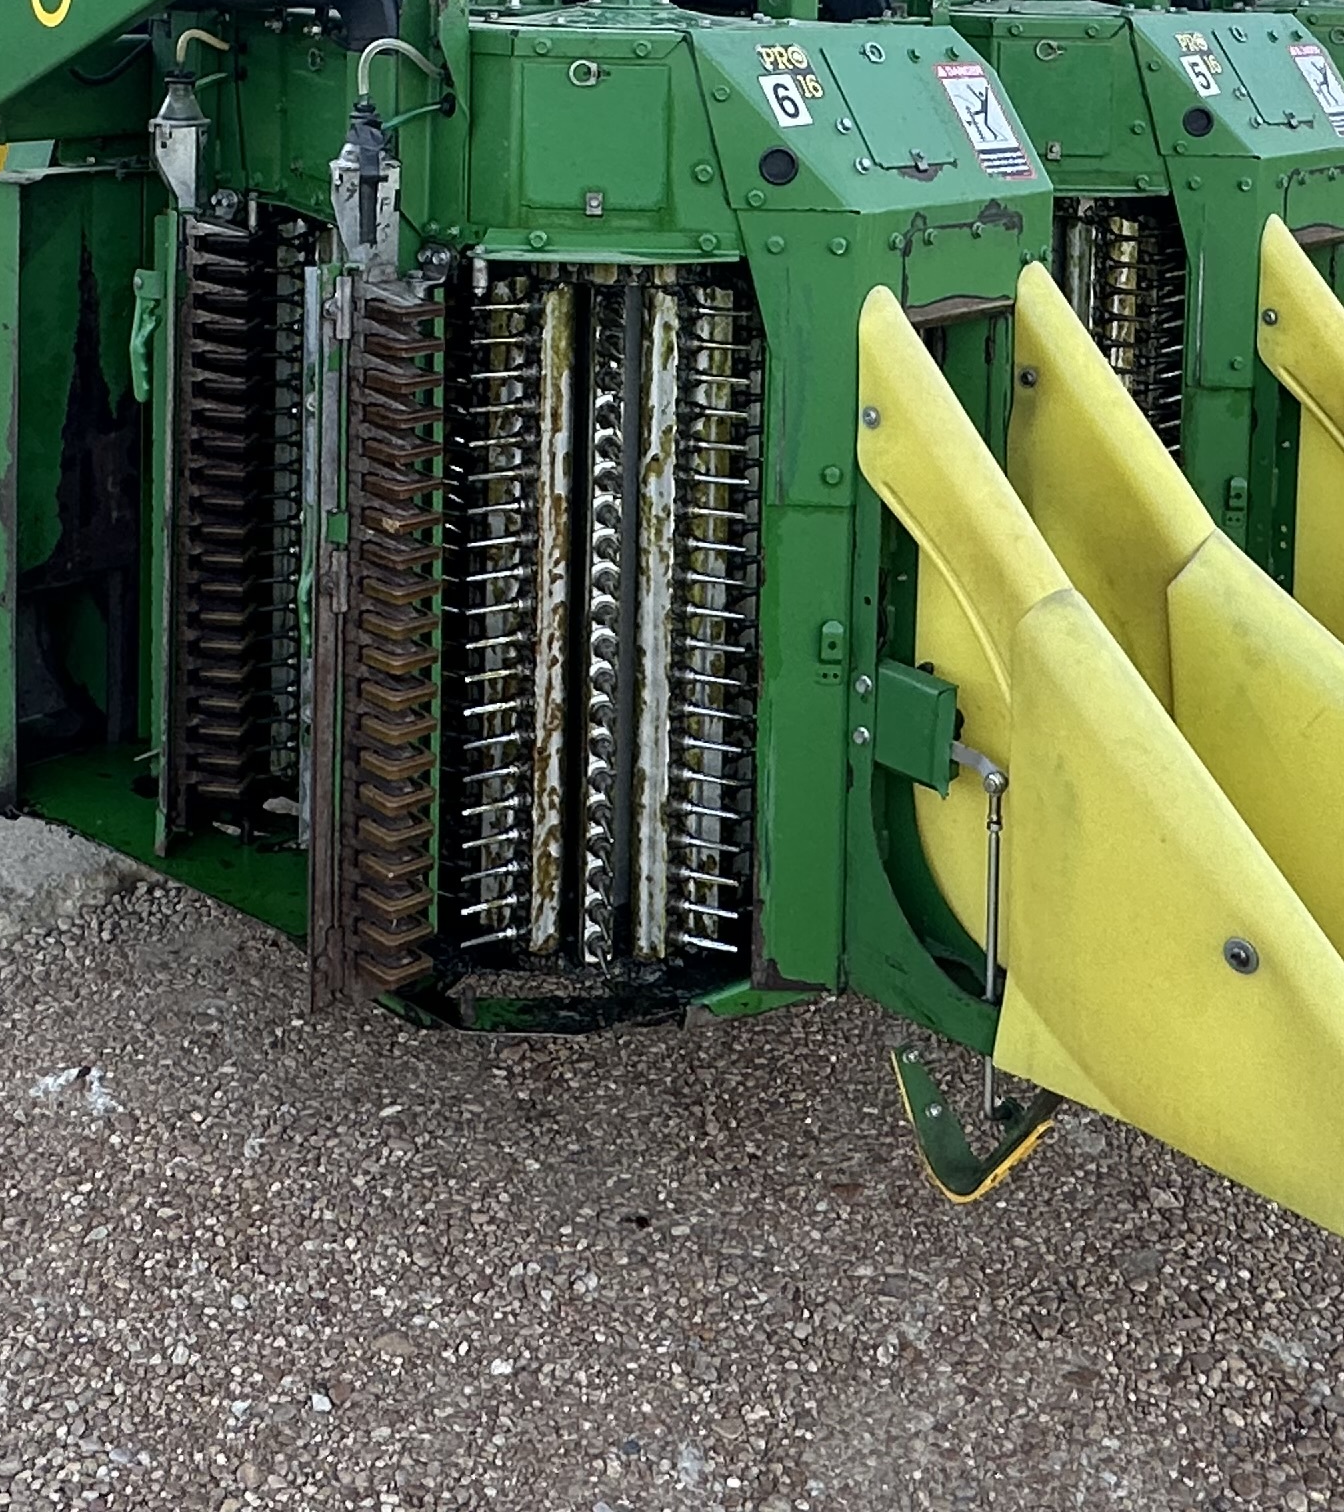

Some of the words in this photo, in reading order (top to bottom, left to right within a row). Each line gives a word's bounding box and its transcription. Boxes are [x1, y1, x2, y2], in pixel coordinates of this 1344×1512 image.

[756, 45, 808, 72] PRO
[796, 74, 824, 98] 16
[1187, 61, 1211, 90] 5
[772, 82, 800, 119] 6
